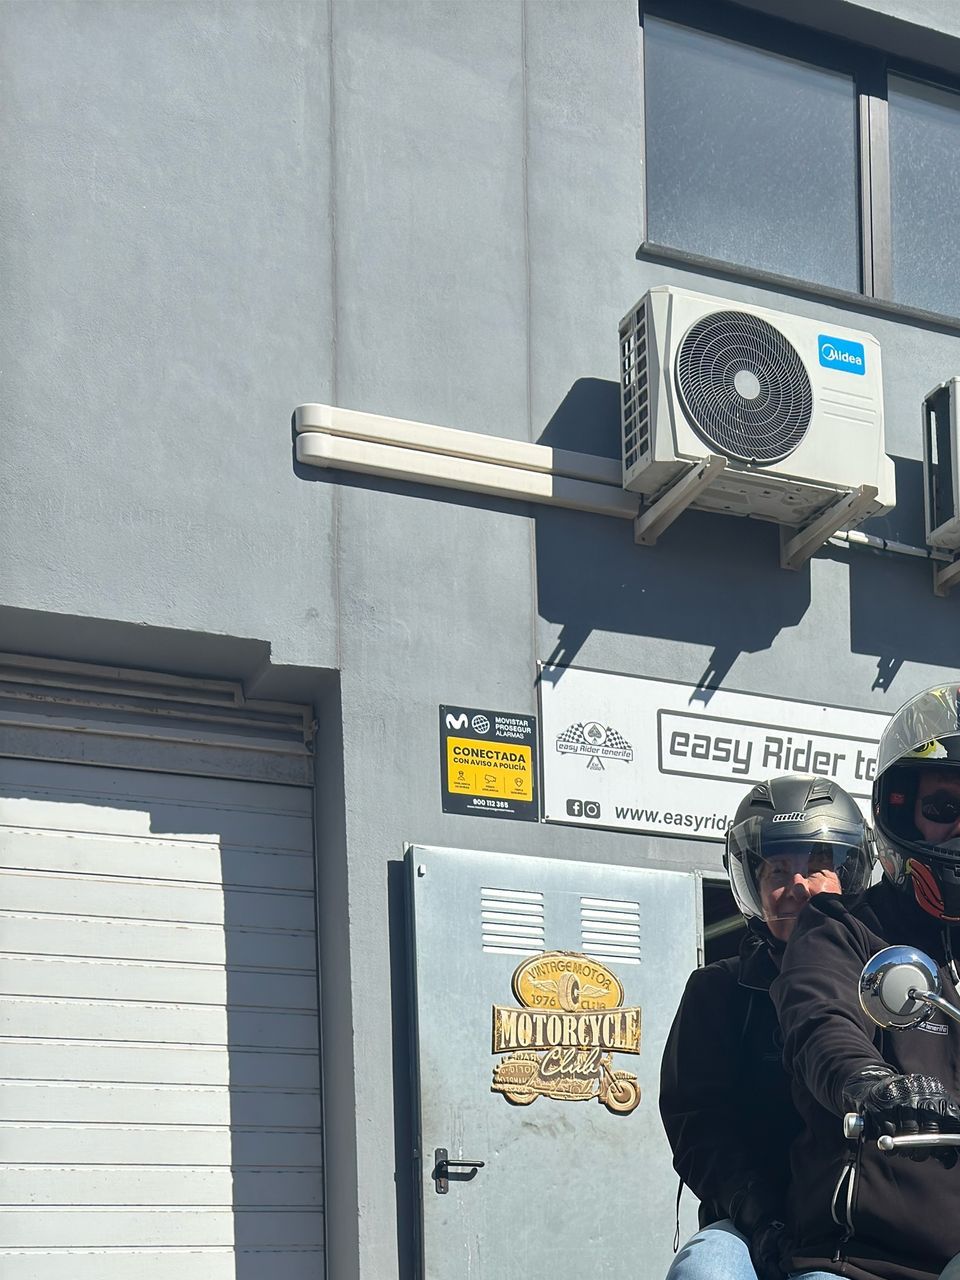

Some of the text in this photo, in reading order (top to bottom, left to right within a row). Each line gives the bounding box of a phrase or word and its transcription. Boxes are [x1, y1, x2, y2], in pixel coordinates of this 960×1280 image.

[822, 343, 862, 366] Midea
[495, 717, 528, 727] MOVISTAR
[495, 724, 531, 734] PROSEGUR
[495, 731, 525, 739] ALARMAS
[453, 746, 526, 763] CONECTADA
[559, 743, 631, 758] easy Rider tenerife
[669, 730, 753, 774] easy
[762, 736, 845, 777] Rider
[453, 757, 470, 765] CON
[470, 759, 492, 767] AVISO
[499, 762, 527, 771] POLICÍA
[528, 960, 612, 990] VINTAGE MOTOR
[532, 994, 556, 1007] 1976
[500, 1010, 638, 1050] MOTORCYCLE
[541, 1047, 600, 1076] Club
